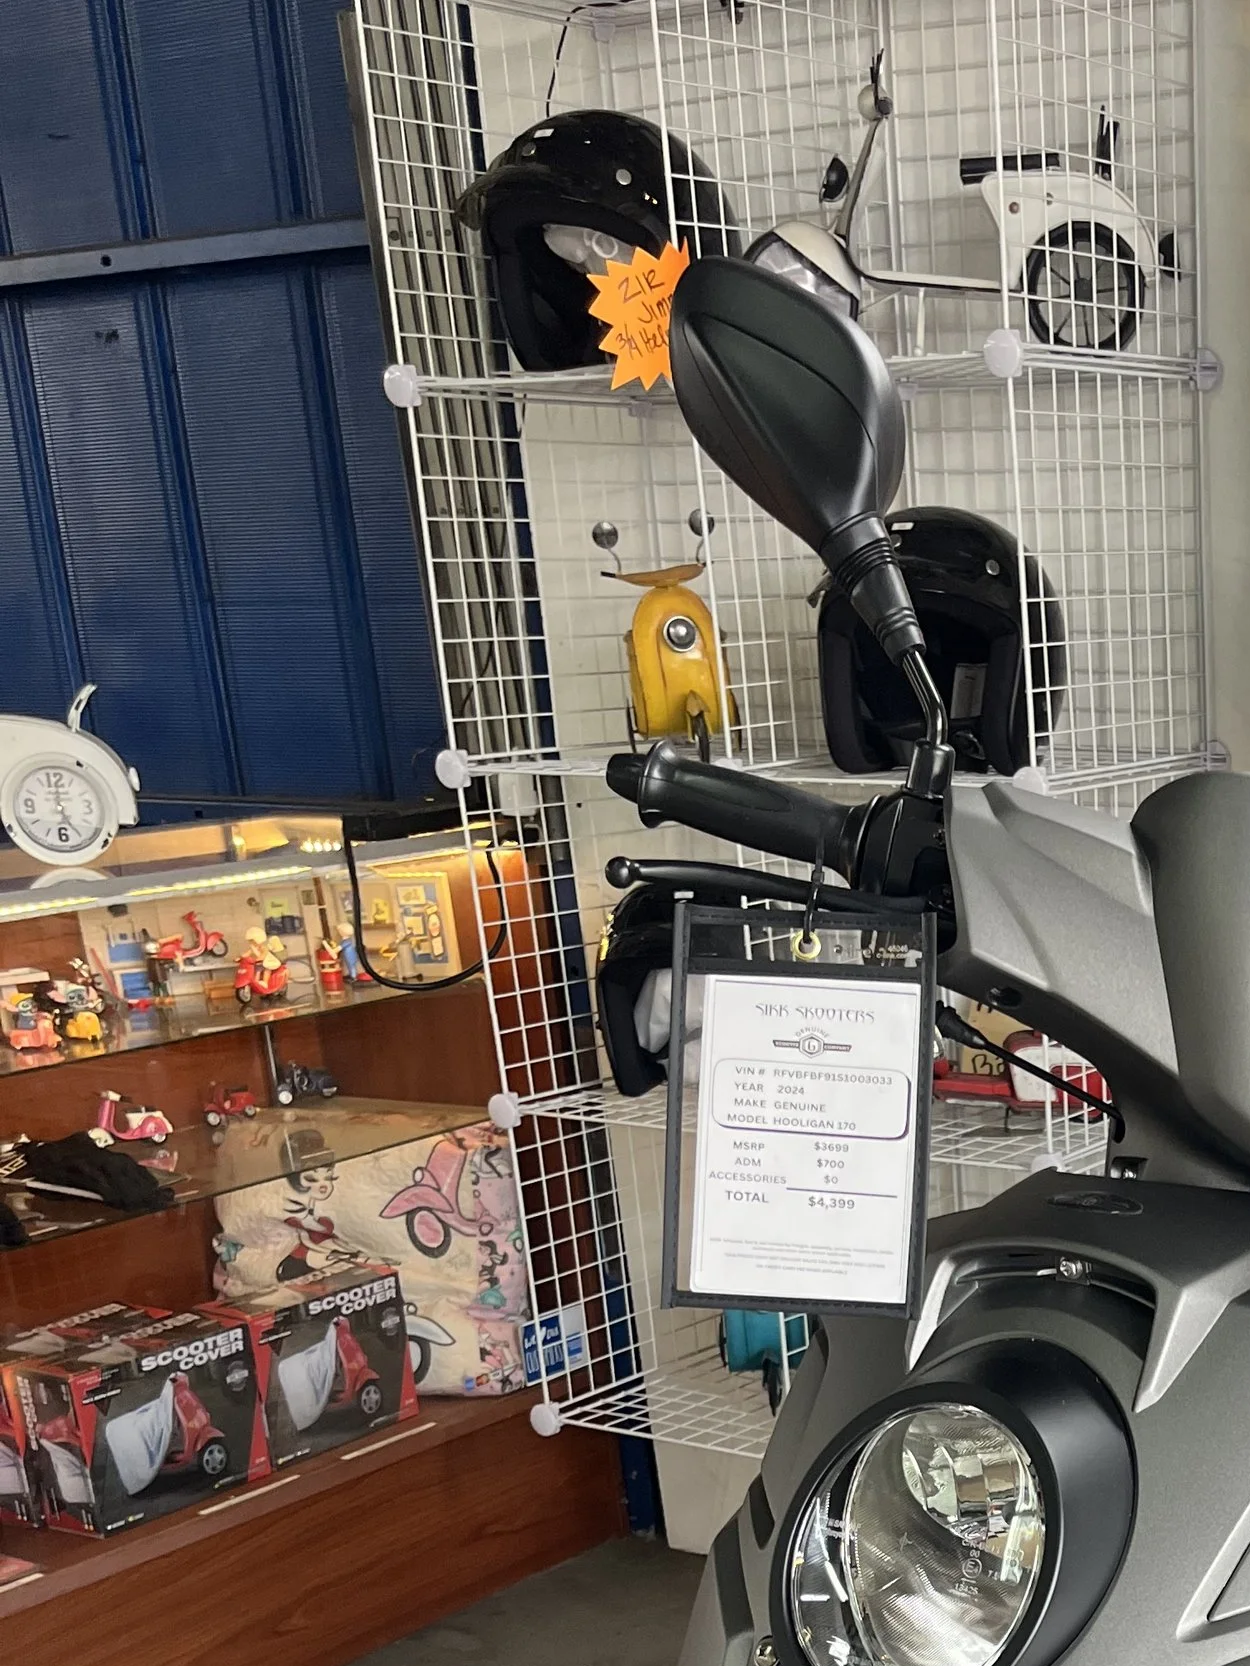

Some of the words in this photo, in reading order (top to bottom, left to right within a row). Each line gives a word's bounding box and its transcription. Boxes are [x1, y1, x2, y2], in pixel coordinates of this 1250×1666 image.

[639, 324, 669, 354] Hel
[46, 772, 65, 788] 12
[23, 797, 36, 814] 9
[82, 799, 93, 815] 3
[57, 826, 70, 843] 6
[756, 1003, 789, 1018] SIKK
[795, 1006, 876, 1024] SKOOTERS
[735, 1066, 755, 1076] VIN
[758, 1067, 766, 1076] #
[734, 1083, 764, 1093] YEAR
[777, 1085, 805, 1095] 2024
[734, 1098, 766, 1108] MAKE
[774, 1101, 827, 1112] GENUINE
[727, 1113, 768, 1125] MODEL
[773, 1116, 834, 1129] HOOLIGAN
[837, 1121, 856, 1131] 170
[733, 1141, 765, 1151] MSRP
[814, 1142, 849, 1153] $3699
[734, 1157, 761, 1167] ADM
[816, 1158, 845, 1169] $700
[709, 1170, 787, 1184] ACCESSORIES
[824, 1175, 838, 1184] $0
[725, 1190, 769, 1203] TOTAL
[808, 1195, 855, 1210] $4,399
[308, 1276, 397, 1315] SCOOTER
[340, 1287, 397, 1315] COVER
[141, 1327, 244, 1372] SCOOTER
[179, 1340, 244, 1371] COVER
